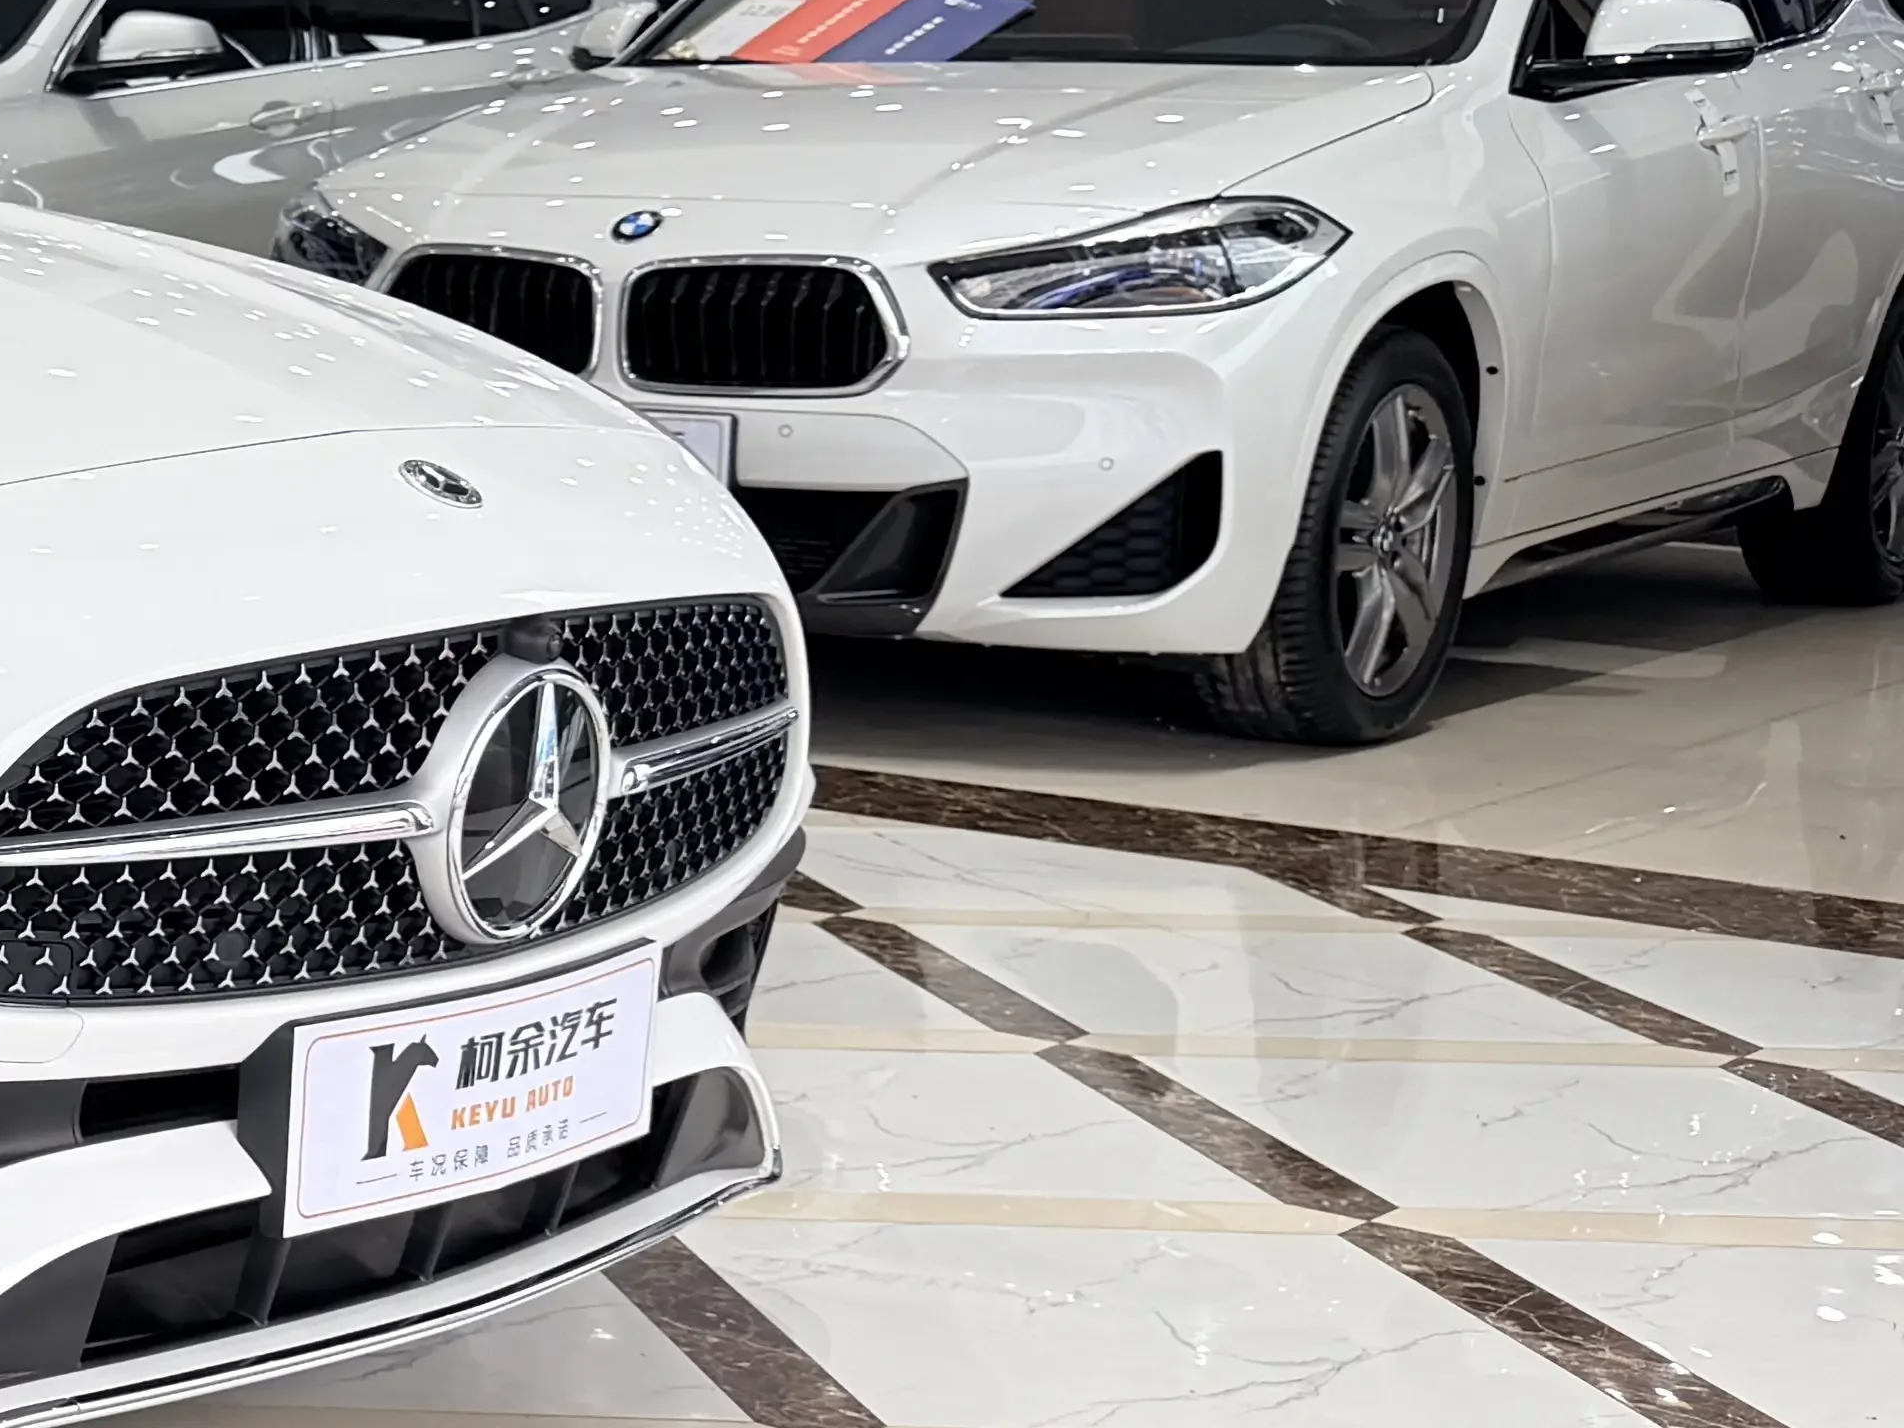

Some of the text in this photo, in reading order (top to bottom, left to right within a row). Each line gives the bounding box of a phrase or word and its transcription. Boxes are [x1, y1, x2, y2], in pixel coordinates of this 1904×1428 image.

[455, 997, 618, 1091] 柯余汽车
[450, 1075, 574, 1131] KEYU AUTO
